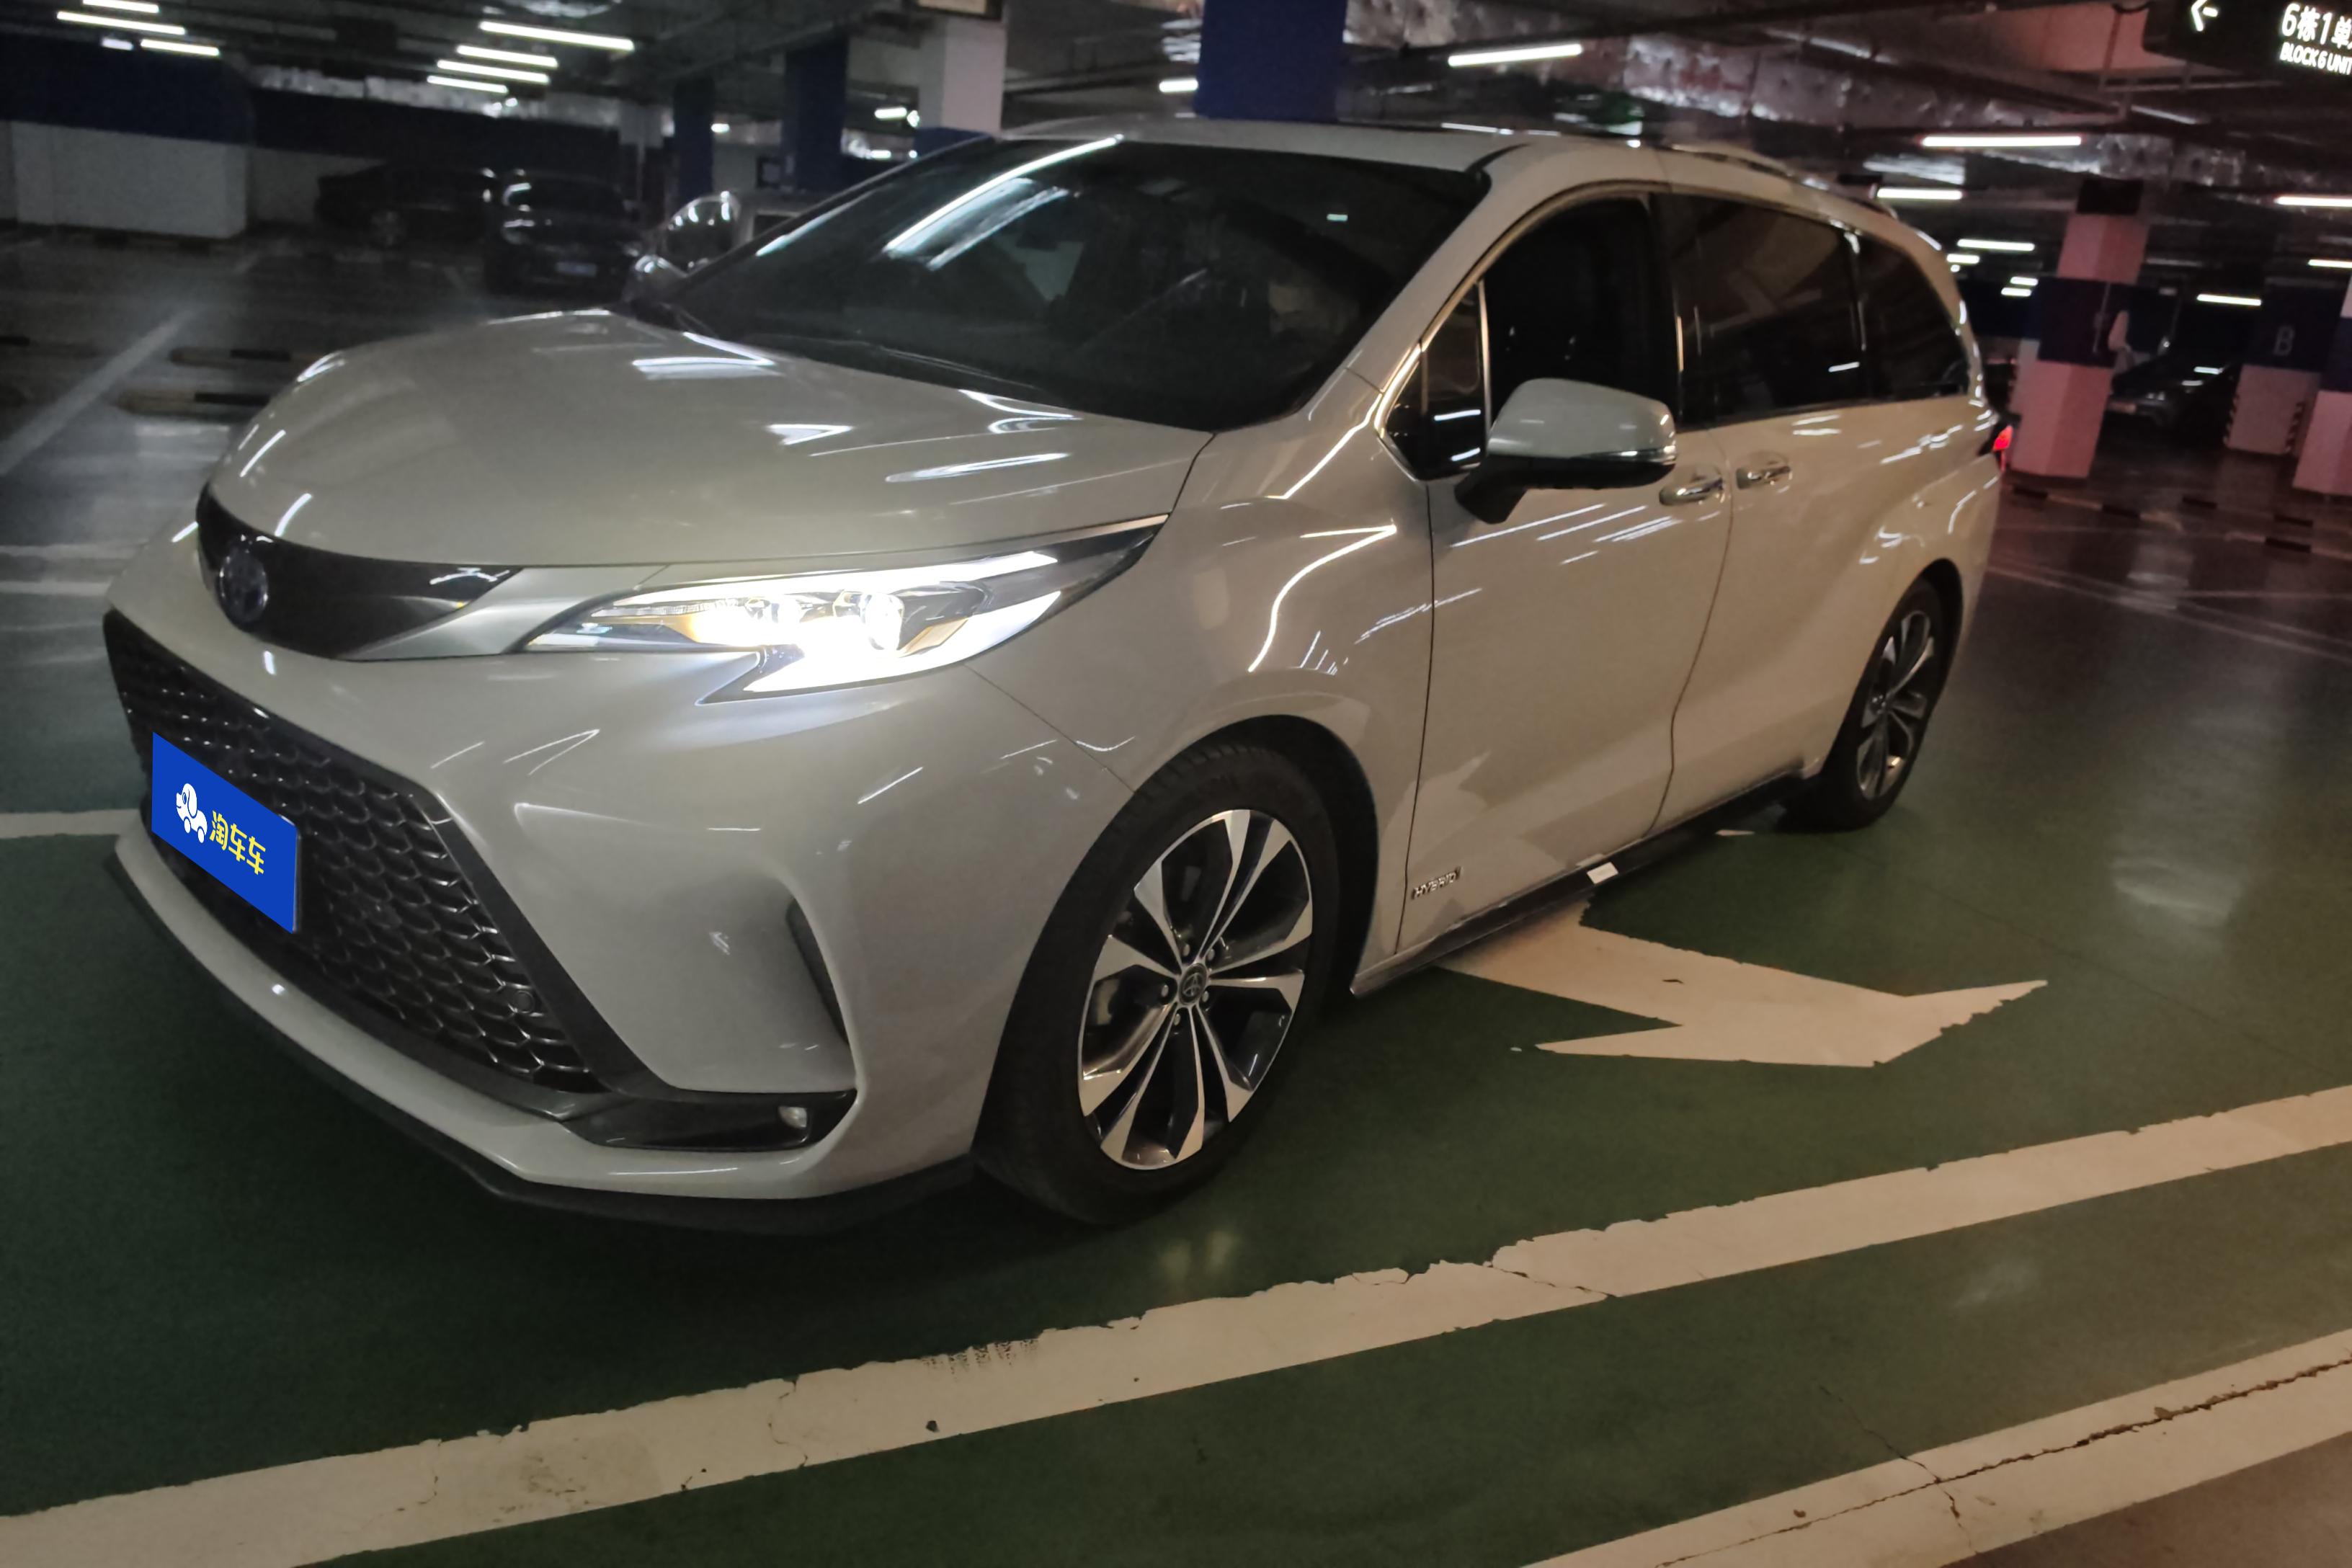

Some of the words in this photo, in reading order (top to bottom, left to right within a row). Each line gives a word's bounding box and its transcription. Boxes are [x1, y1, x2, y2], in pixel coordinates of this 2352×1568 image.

[2282, 3, 2352, 50] 6栋1单
[2279, 42, 2320, 67] BLOCK
[2317, 50, 2328, 69] 6
[1411, 867, 1461, 899] HYBRID
